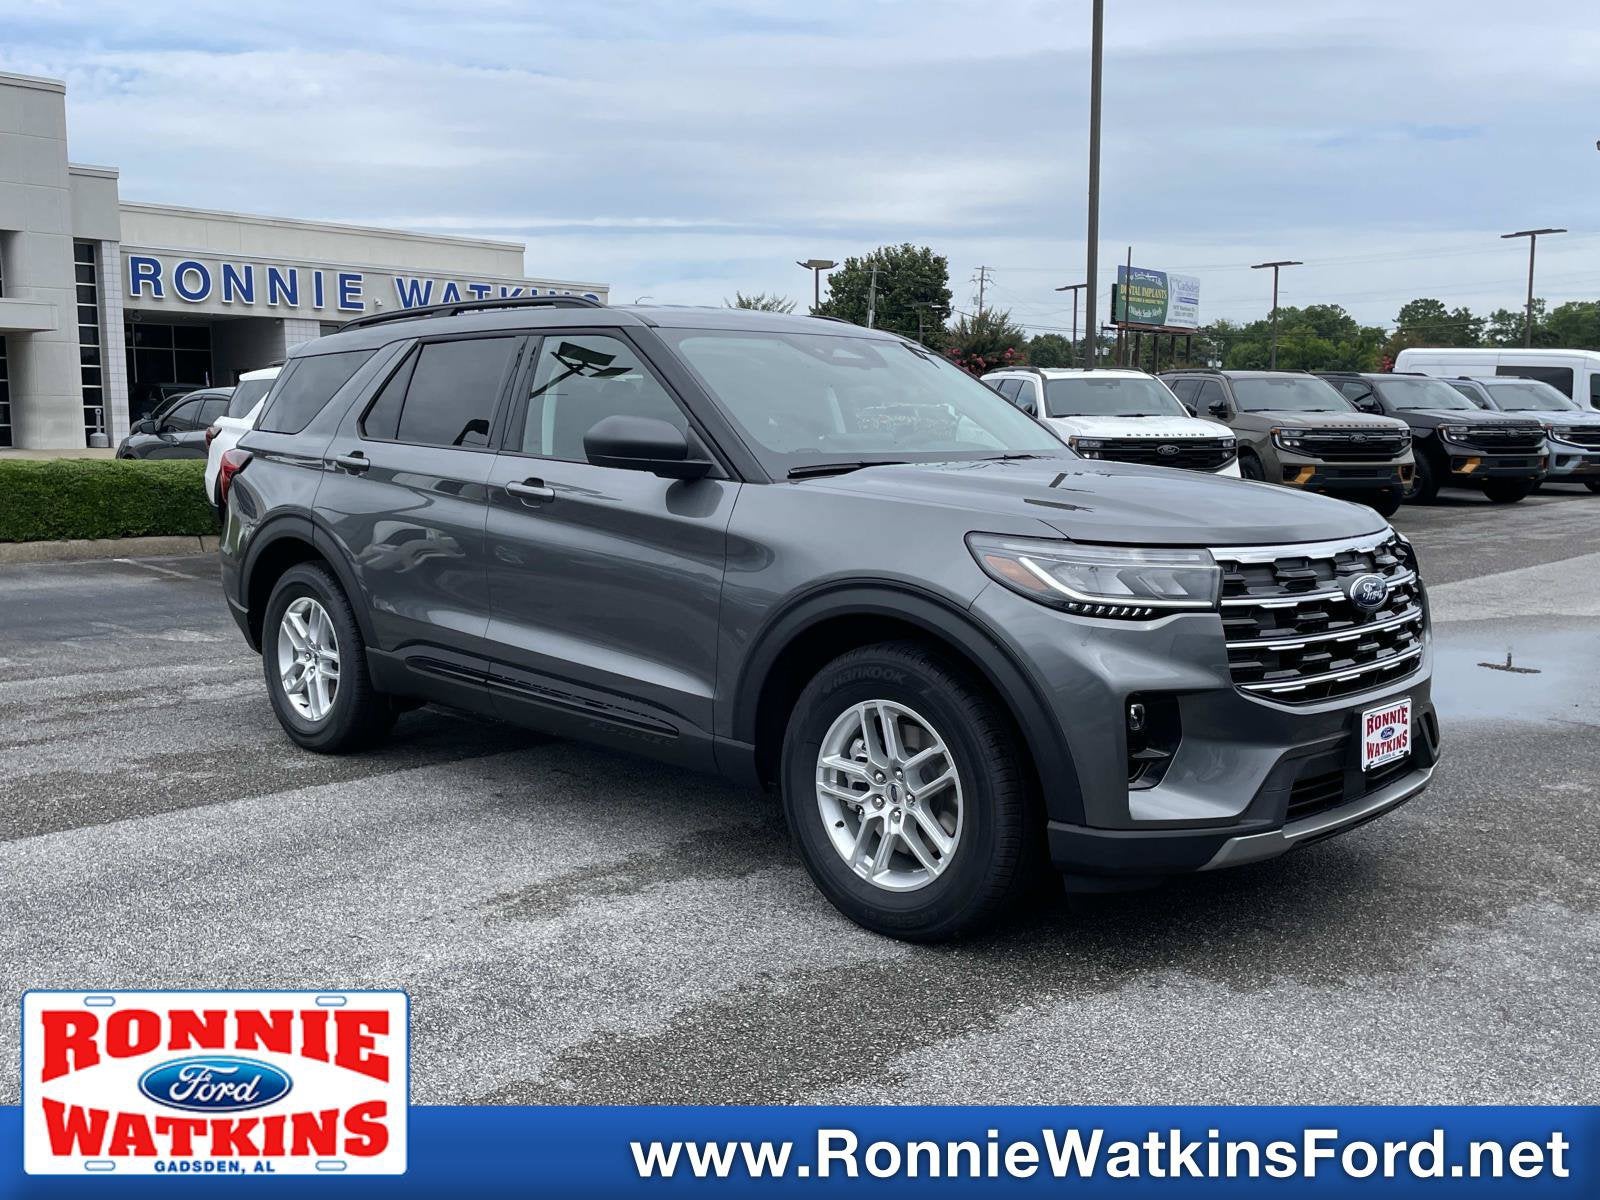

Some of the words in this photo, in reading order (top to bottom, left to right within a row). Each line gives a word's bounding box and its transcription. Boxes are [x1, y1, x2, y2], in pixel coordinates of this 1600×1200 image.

[128, 254, 367, 311] RONNIE
[394, 276, 600, 310] WATK
[1366, 706, 1408, 737] RONNIE
[1366, 729, 1408, 760] WATKINS
